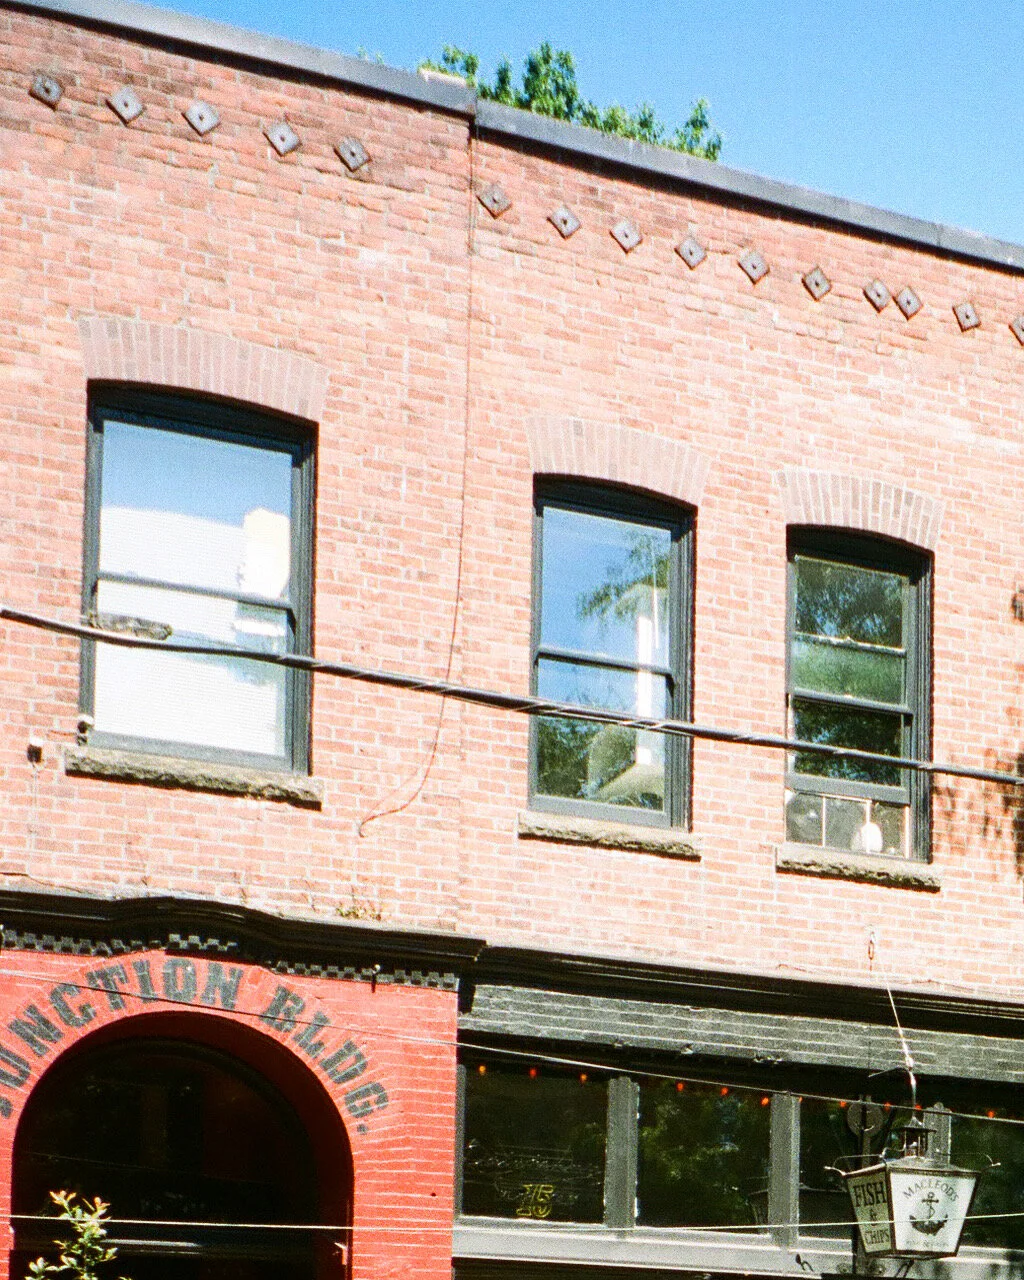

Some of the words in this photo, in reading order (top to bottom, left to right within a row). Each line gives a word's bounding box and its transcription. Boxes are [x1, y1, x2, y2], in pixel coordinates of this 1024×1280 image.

[0, 956, 243, 1119] UNCTION
[259, 985, 389, 1135] BLDG.
[853, 1181, 888, 1208] FISH
[868, 1208, 878, 1227] &
[864, 1229, 890, 1245] CHIPS
